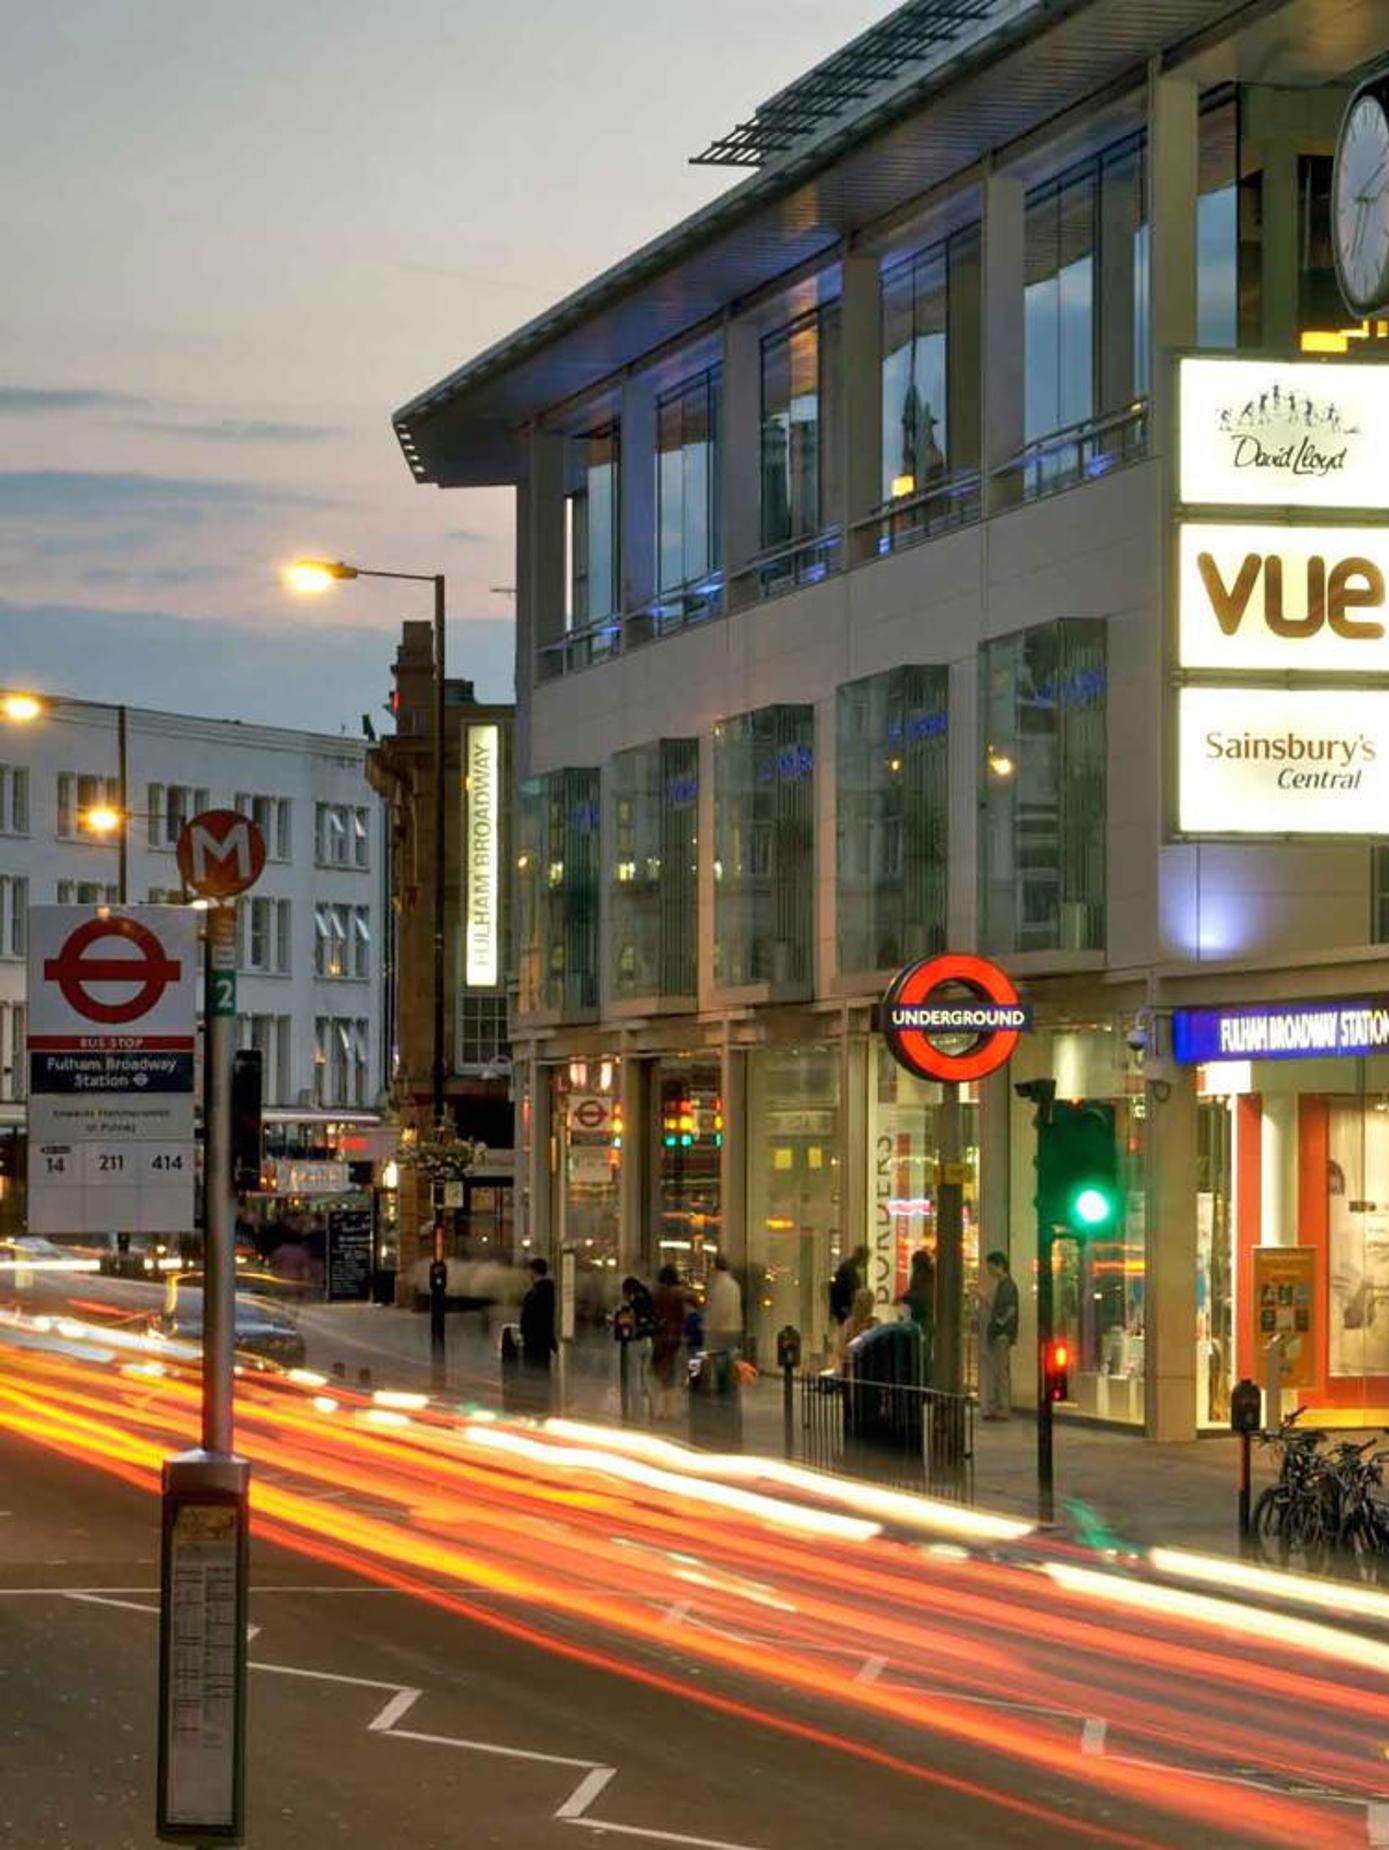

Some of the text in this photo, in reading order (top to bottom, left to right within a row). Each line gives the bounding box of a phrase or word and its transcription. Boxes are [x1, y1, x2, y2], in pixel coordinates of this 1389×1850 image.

[1231, 434, 1348, 476] David Lloyd
[1205, 730, 1376, 767] Sainsbury's
[1277, 768, 1362, 791] Central
[473, 743, 491, 866] BROADWAY
[891, 1009, 1026, 1026] UNDERGROUND
[80, 1037, 144, 1048] BUS STOP
[1220, 1015, 1268, 1053] FULHAM
[47, 1056, 177, 1075] Fulham Broadway
[74, 1073, 129, 1089] Station
[46, 1157, 65, 1173] 14
[99, 1154, 124, 1170] 211
[152, 1154, 183, 1170] 414
